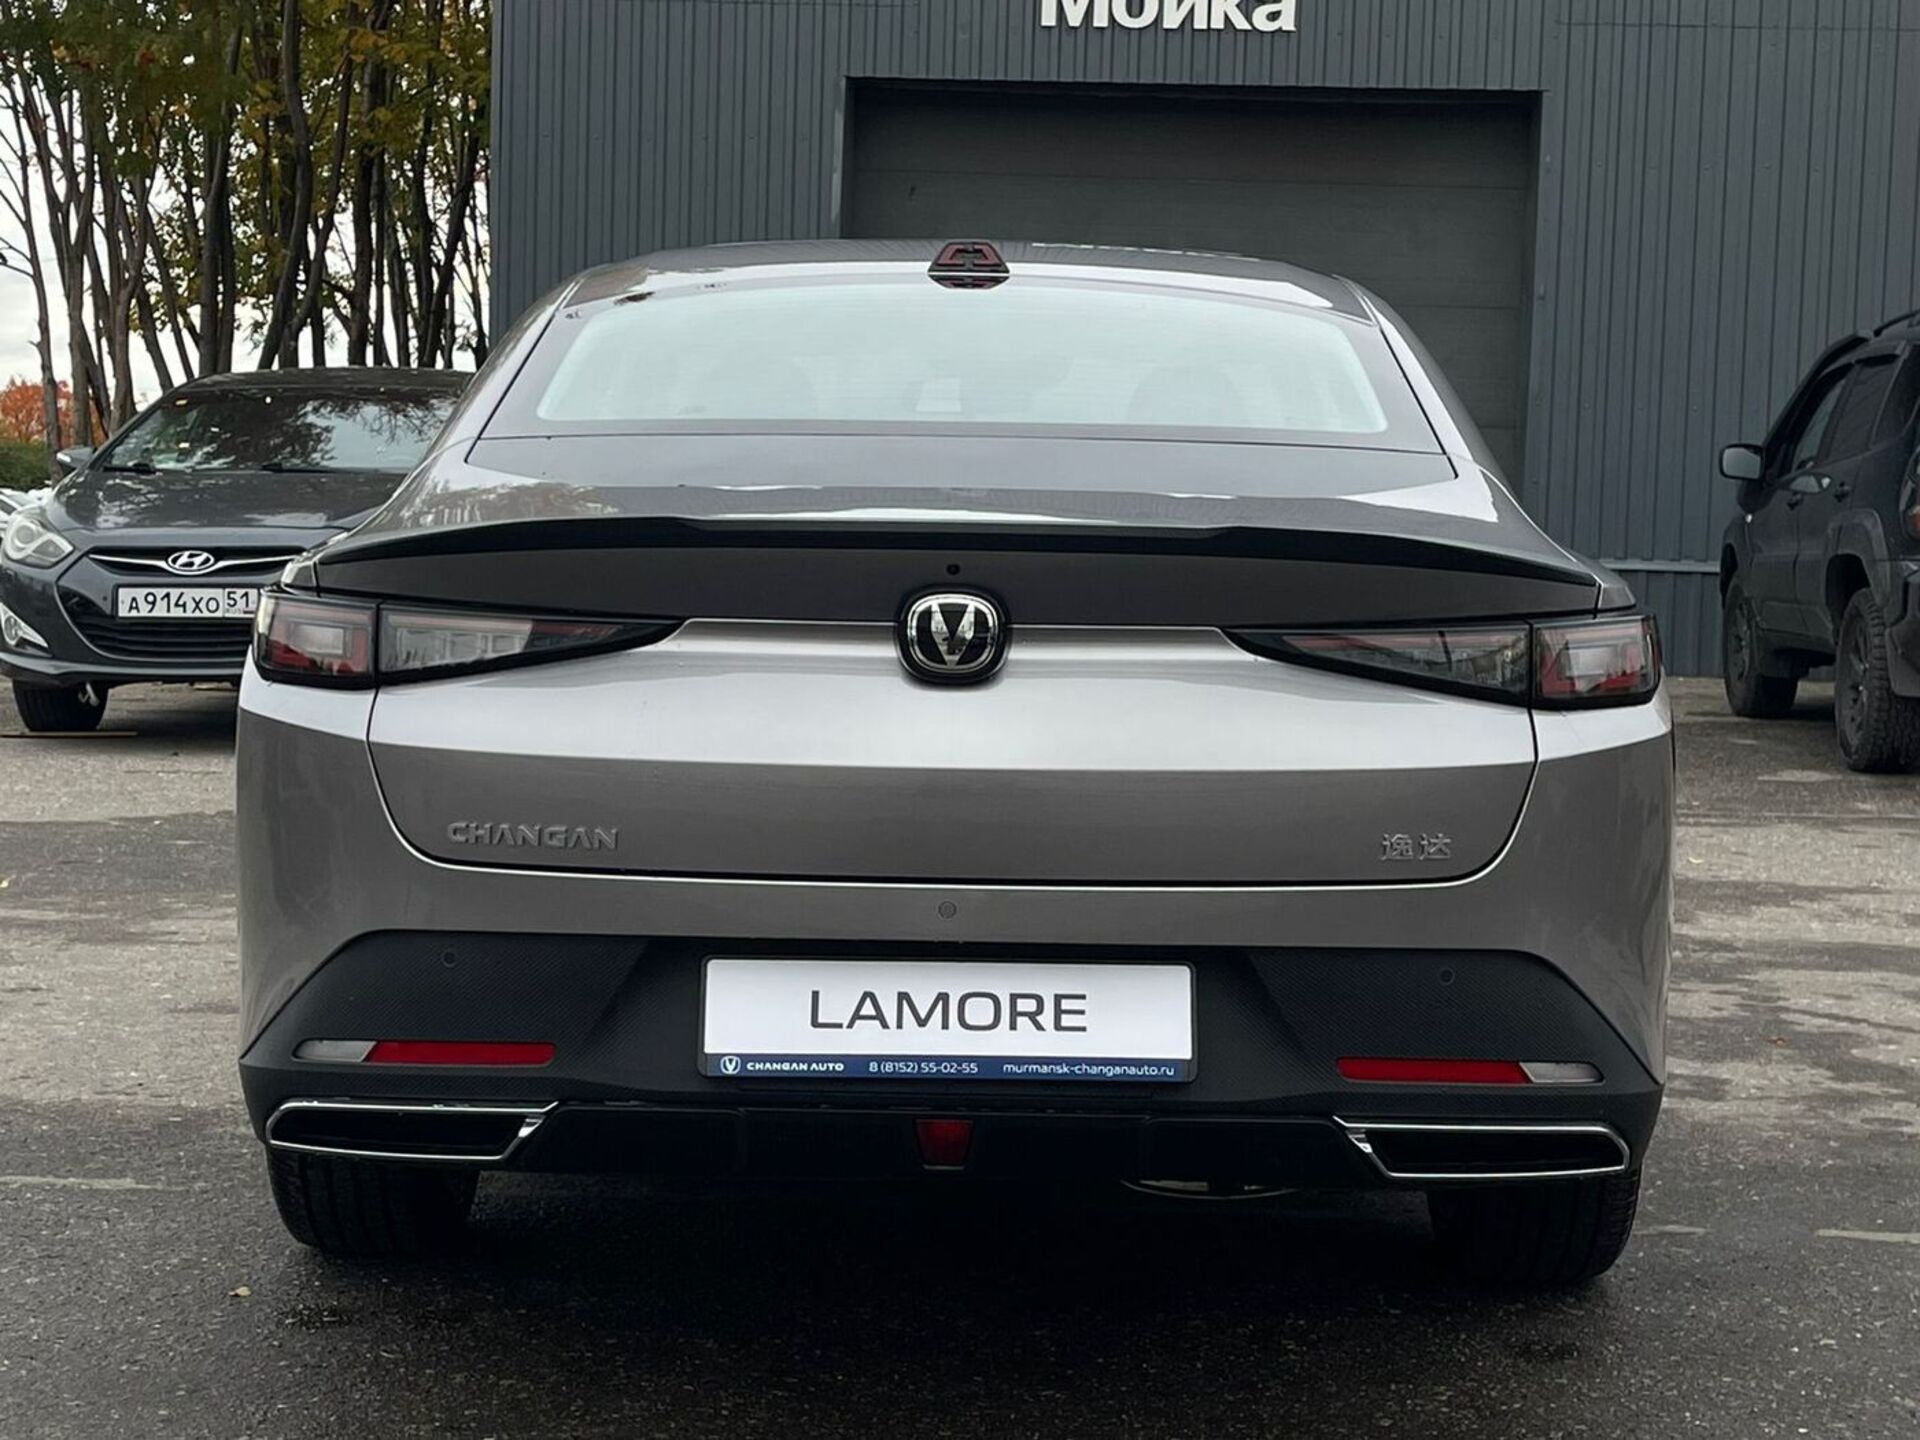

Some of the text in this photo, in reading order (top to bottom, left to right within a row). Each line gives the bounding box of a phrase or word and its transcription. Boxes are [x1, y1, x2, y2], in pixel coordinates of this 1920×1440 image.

[447, 821, 619, 850] CHANGAN
[1381, 833, 1452, 861] 逸达
[810, 990, 1087, 1032] LAMORE
[746, 1061, 1174, 1077] CHANGAN AUTO 8 (8152) 55-02-55 murmansk-changanauto.ru
